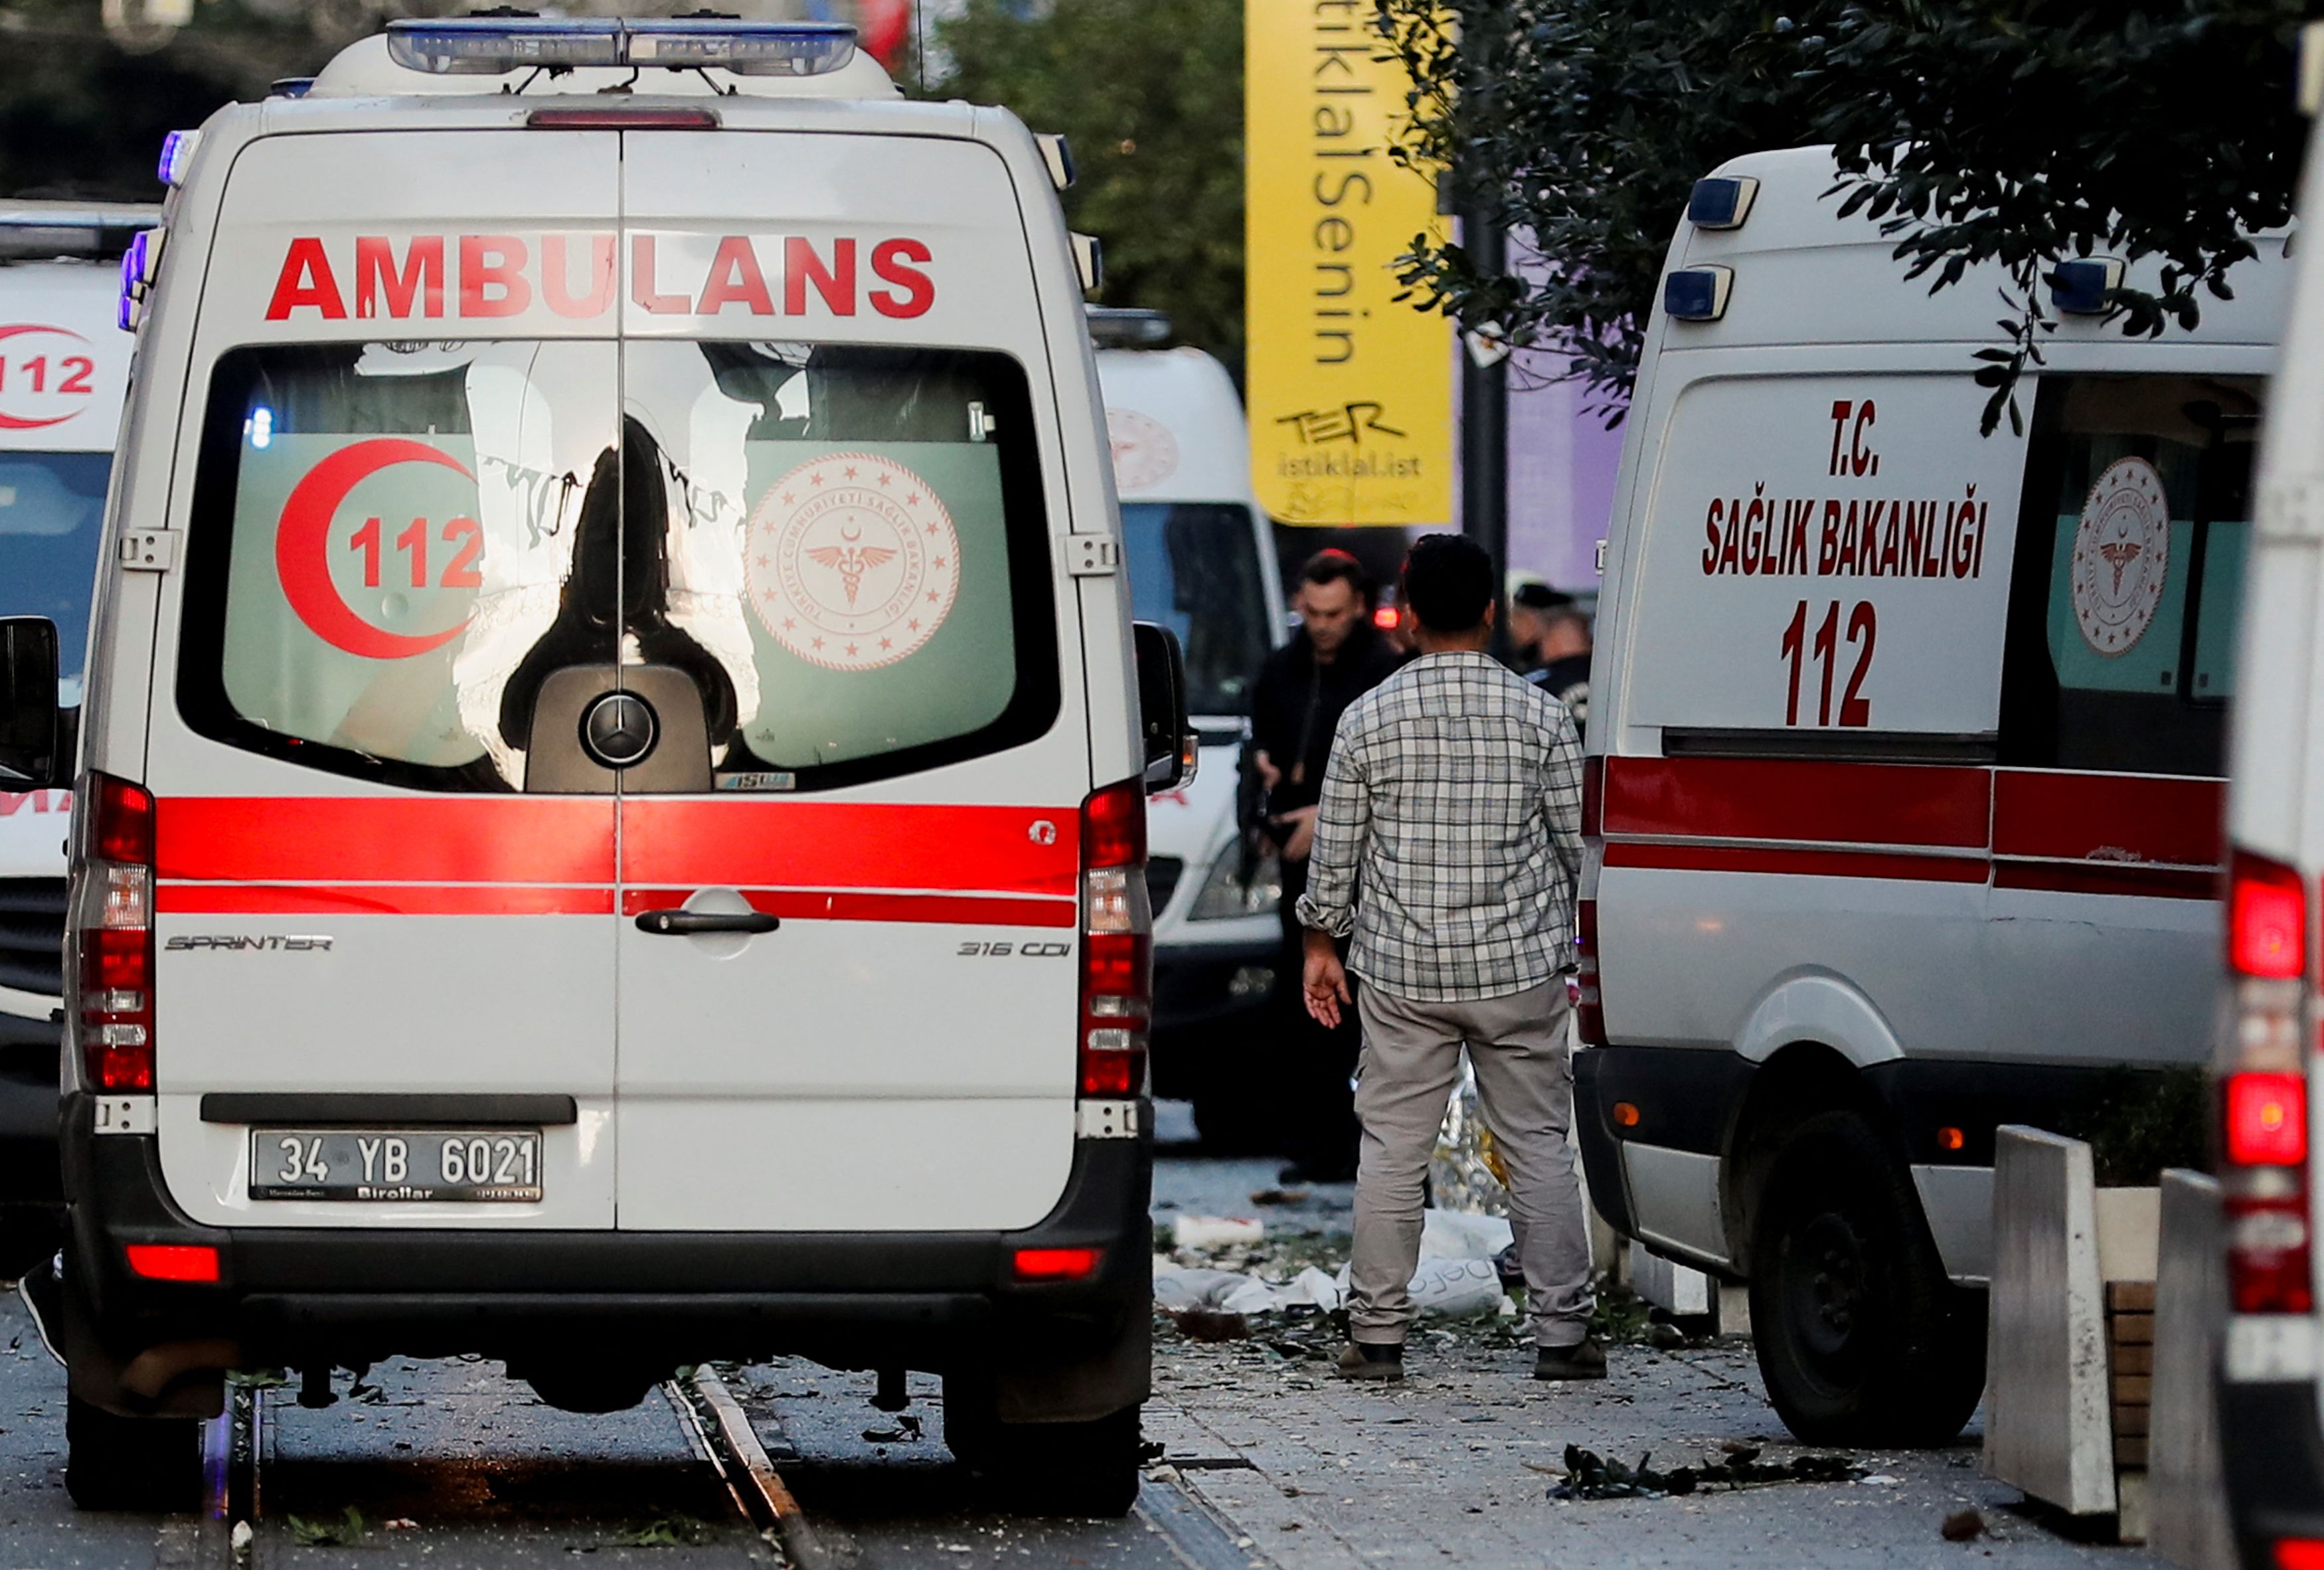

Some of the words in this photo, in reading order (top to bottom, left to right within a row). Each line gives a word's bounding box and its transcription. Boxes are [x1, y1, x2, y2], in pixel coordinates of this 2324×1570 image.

[264, 234, 936, 320] AMBULANS
[1828, 399, 1880, 477] T.C.
[350, 517, 483, 588] 112
[1702, 481, 1815, 576] SAĞLIK
[1817, 483, 1989, 580] BAKANLIĞI
[1781, 600, 1877, 728] 112
[165, 934, 334, 950] SPRINTER
[957, 942, 1013, 956] 316
[1020, 942, 1072, 957] CDI
[279, 1137, 329, 1183] 34
[357, 1138, 408, 1183] YB
[441, 1138, 533, 1185] 6021
